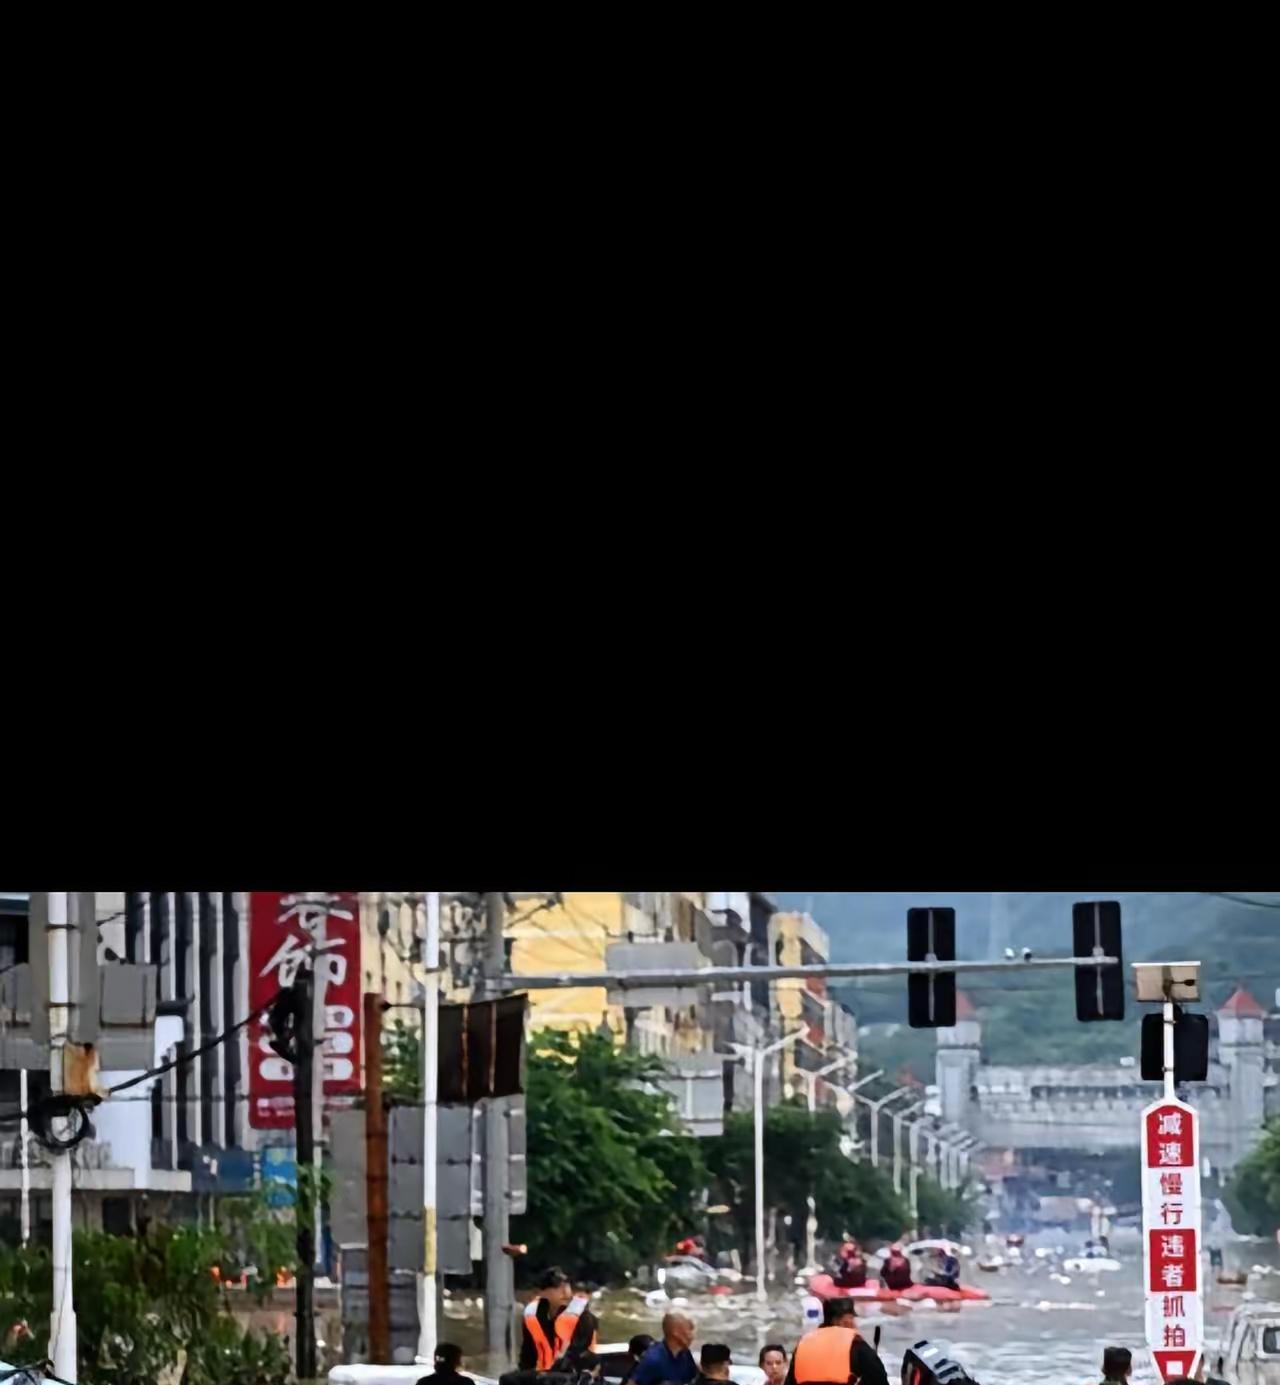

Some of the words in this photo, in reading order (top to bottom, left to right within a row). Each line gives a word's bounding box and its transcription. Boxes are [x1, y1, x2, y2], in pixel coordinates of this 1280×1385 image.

[1157, 1113, 1186, 1347] 减速慢行违者抓拍
